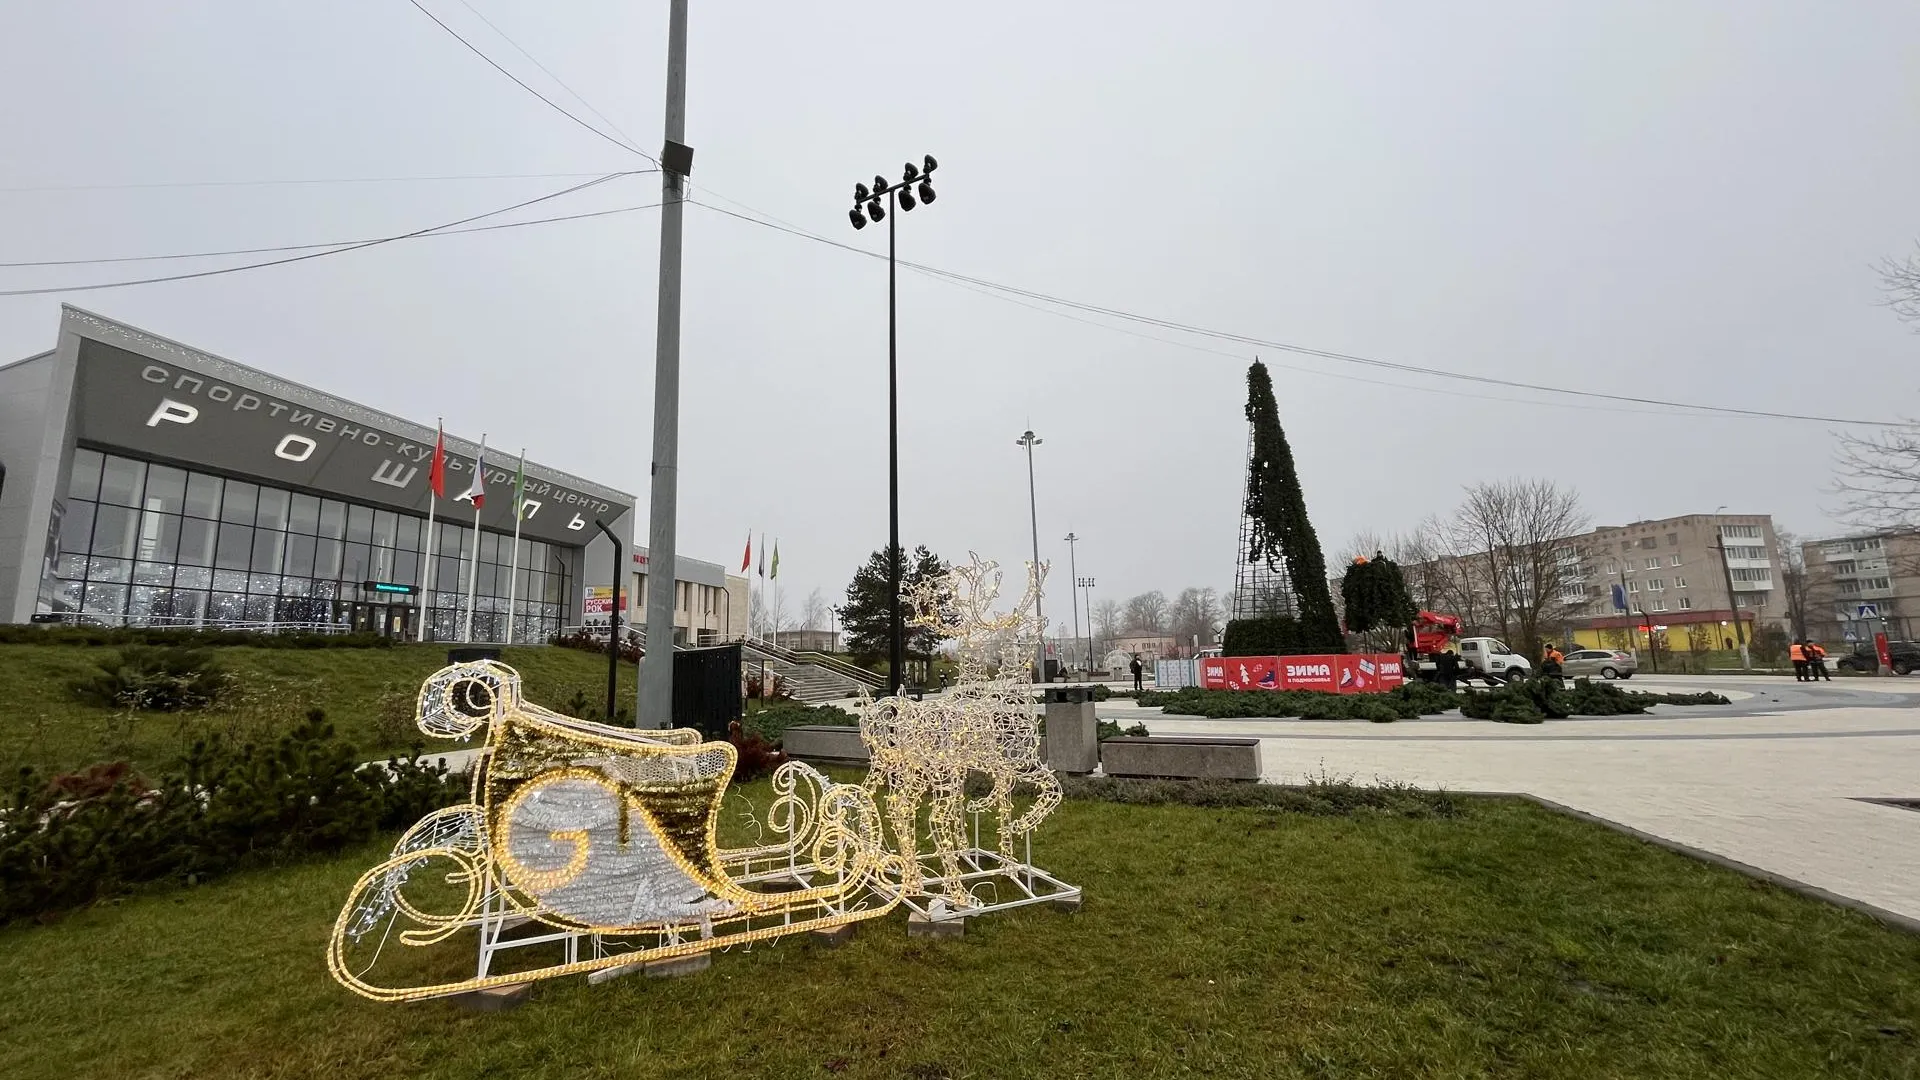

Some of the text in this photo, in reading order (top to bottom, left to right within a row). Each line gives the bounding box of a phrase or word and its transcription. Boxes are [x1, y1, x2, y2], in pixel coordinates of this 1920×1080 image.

[586, 605, 603, 613] РОК
[1207, 666, 1224, 677] ЗИМА
[1286, 664, 1331, 677] ЗИМА
[1380, 662, 1401, 674] ЗИМА
